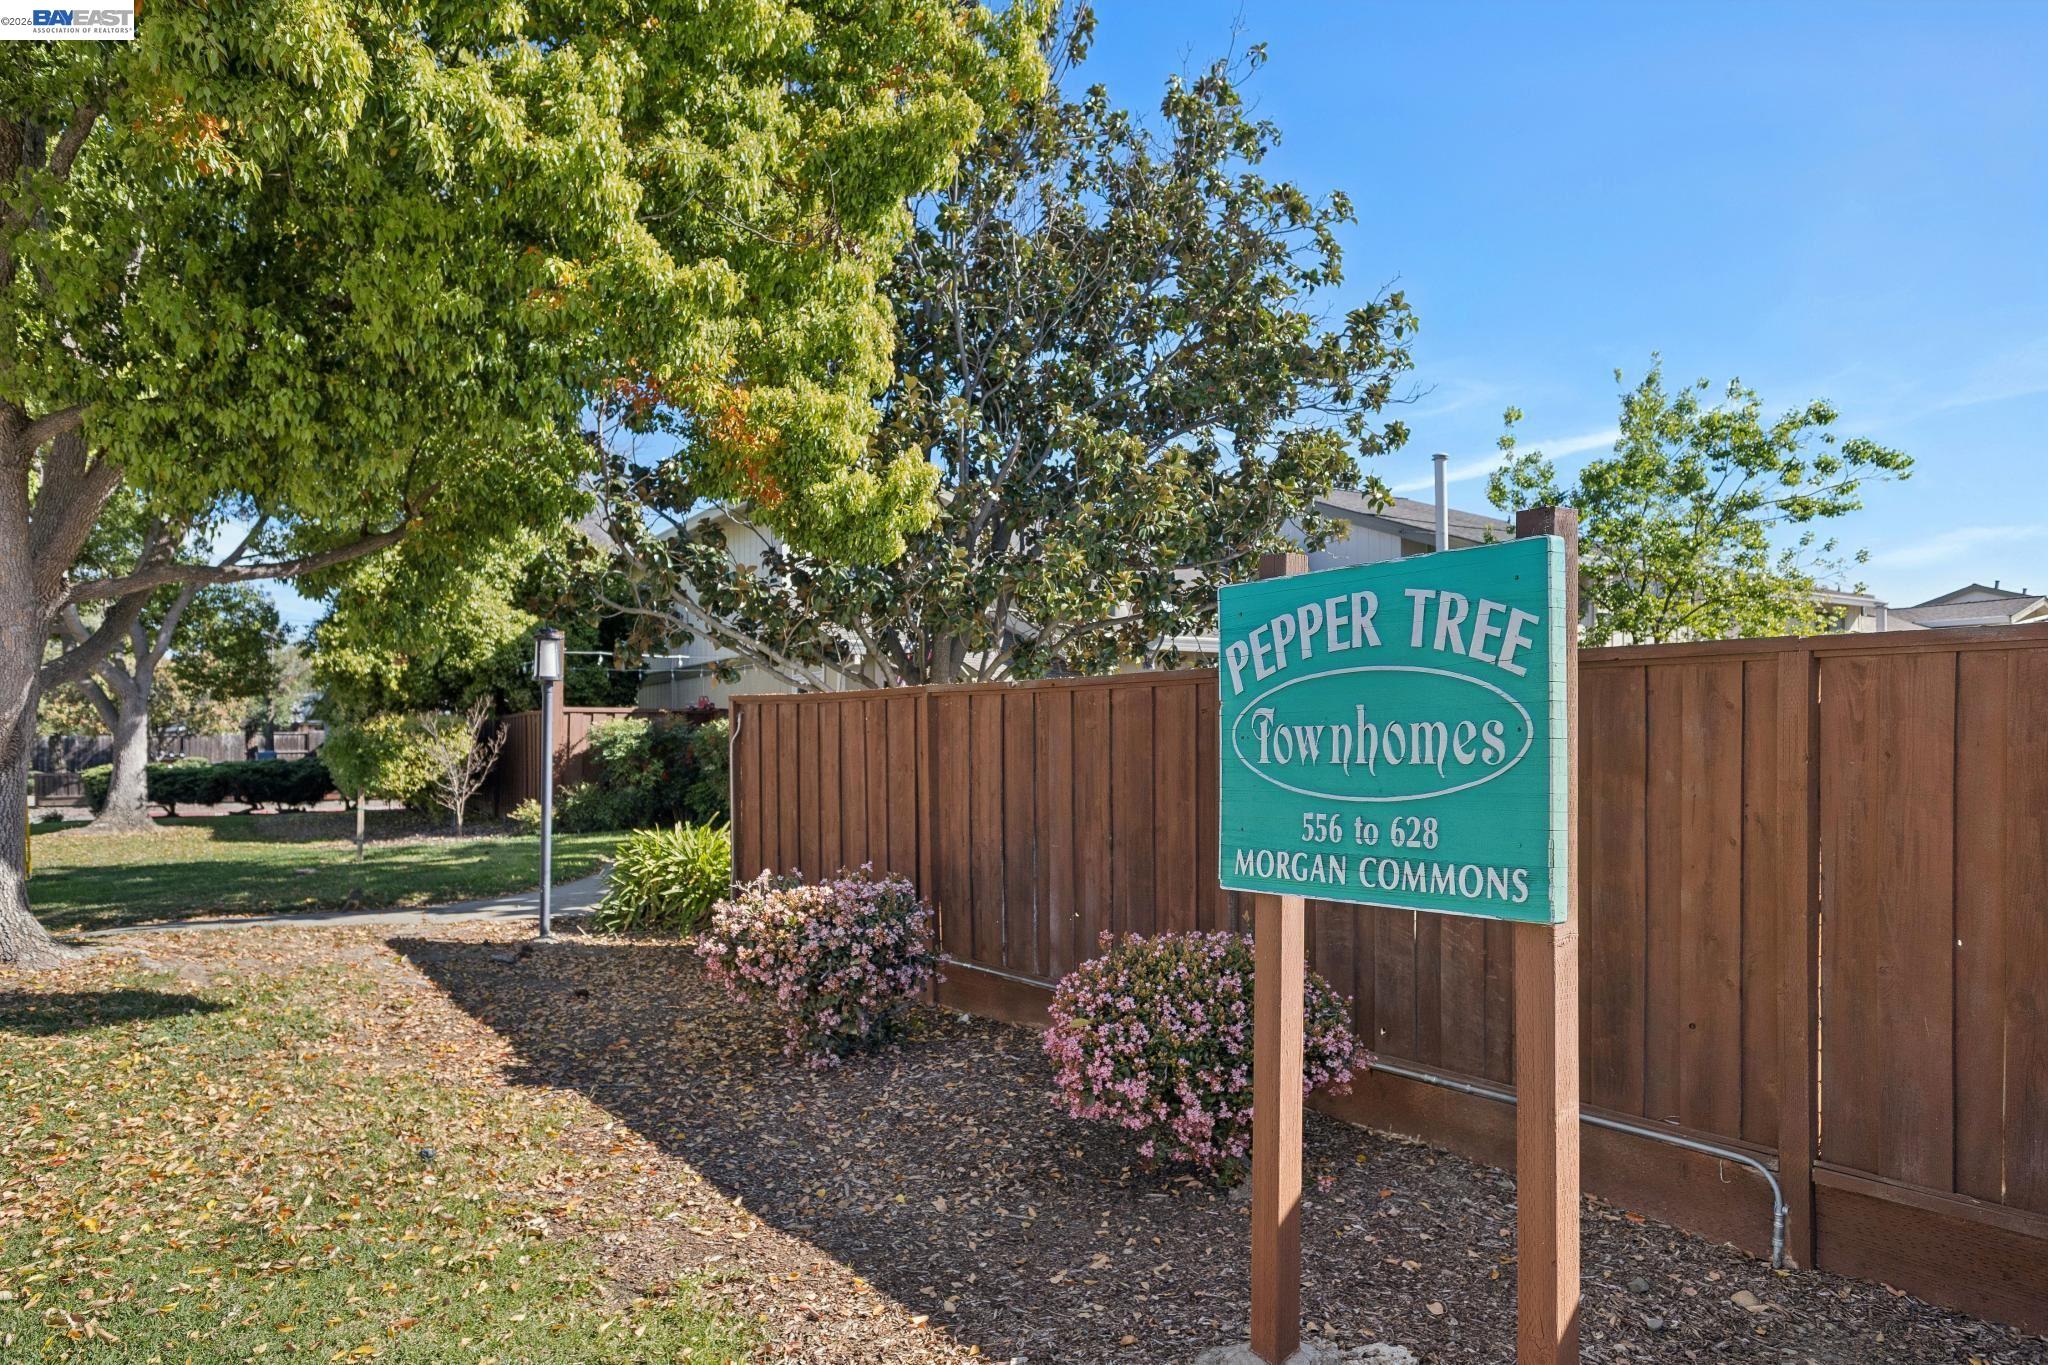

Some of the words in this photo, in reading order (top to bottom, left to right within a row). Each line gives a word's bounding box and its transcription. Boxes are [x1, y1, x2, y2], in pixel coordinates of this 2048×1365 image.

[1225, 590, 1382, 696] PEPPER
[1404, 588, 1540, 678] TREE
[1251, 704, 1506, 778] Townhomes
[1301, 811, 1343, 843] 556
[1354, 815, 1379, 846] to
[1390, 816, 1438, 849] 628
[1234, 848, 1346, 885] MORGAN
[1359, 857, 1529, 904] COMMONS
